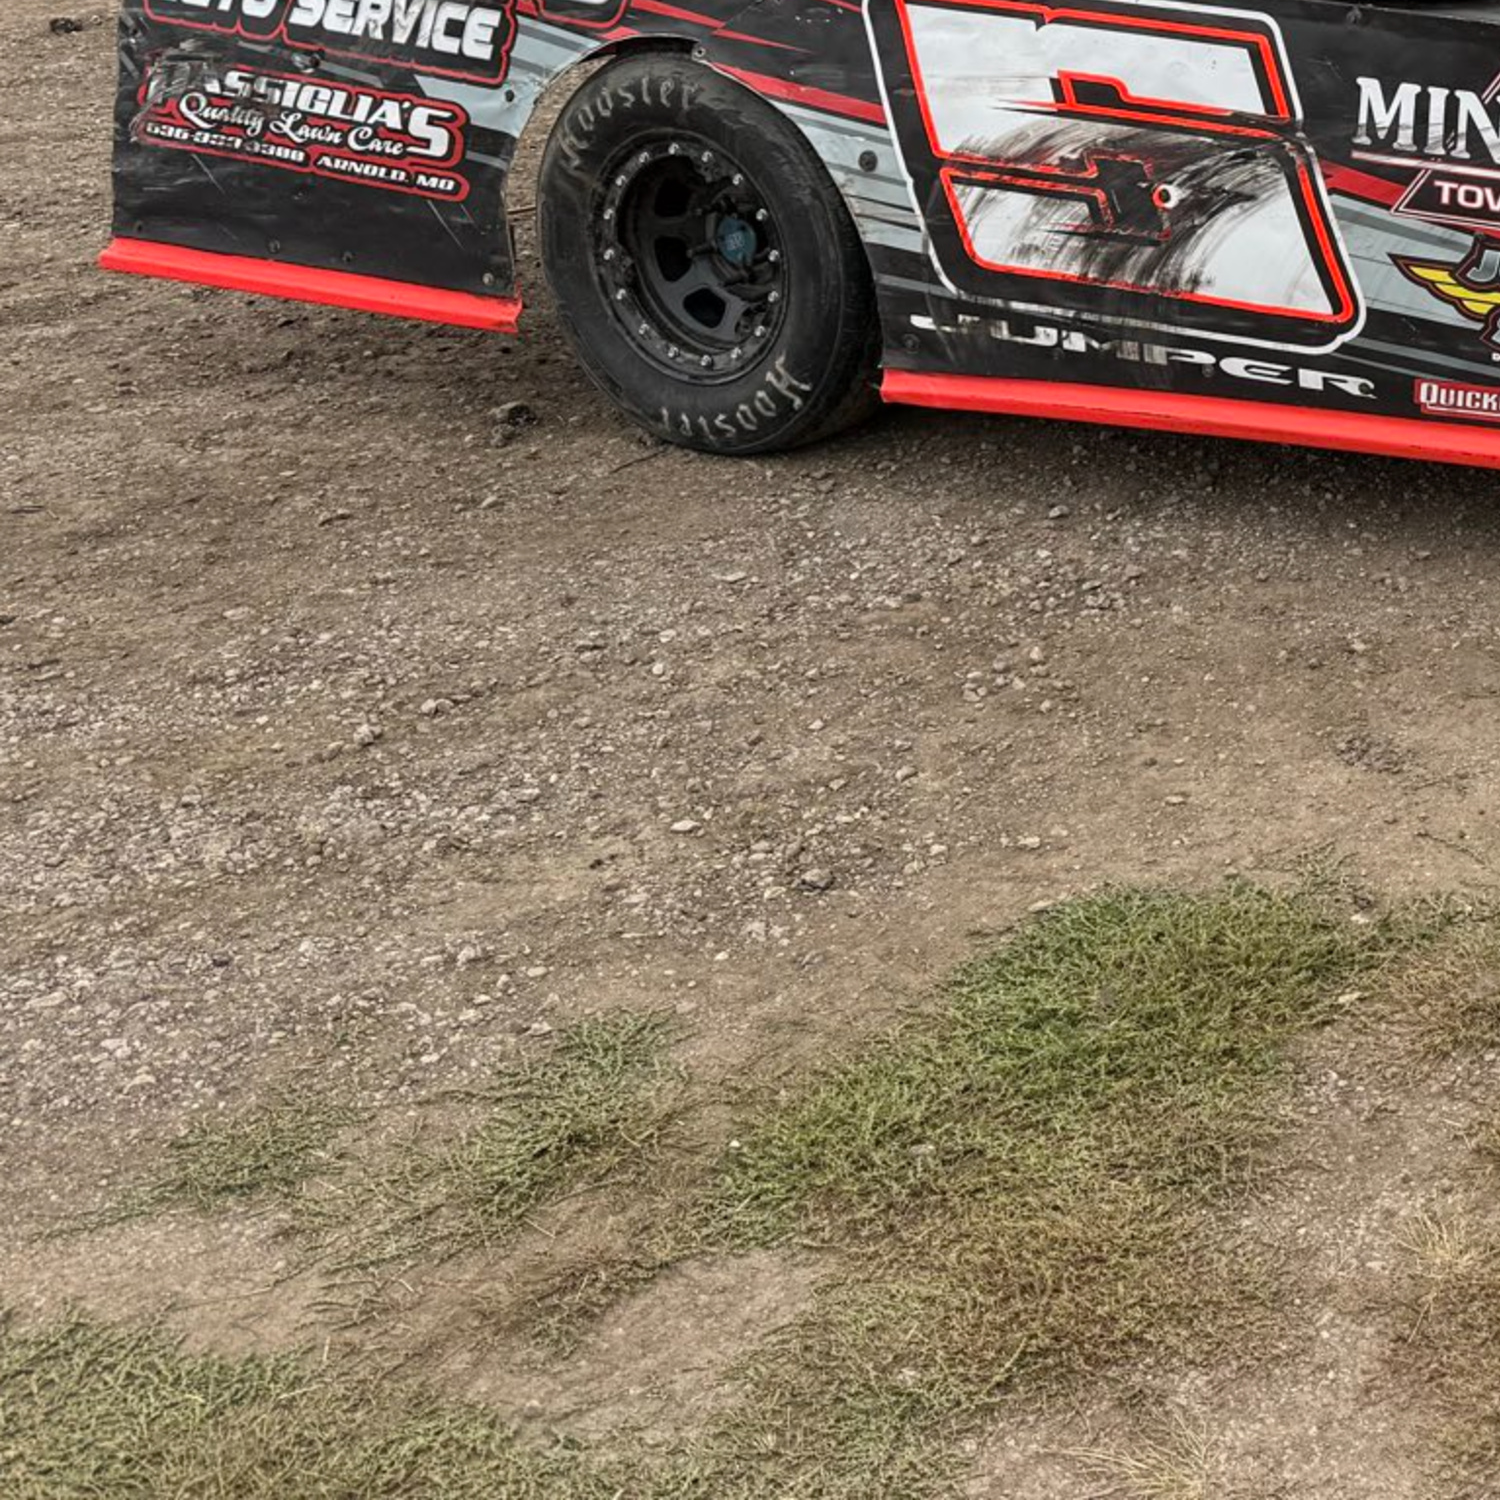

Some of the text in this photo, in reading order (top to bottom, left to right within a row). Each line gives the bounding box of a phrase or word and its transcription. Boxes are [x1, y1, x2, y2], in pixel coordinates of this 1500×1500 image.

[268, 110, 342, 144] Lawn
[347, 126, 403, 156] Care
[415, 173, 456, 191] MO
[909, 314, 1377, 399] JUMPER
